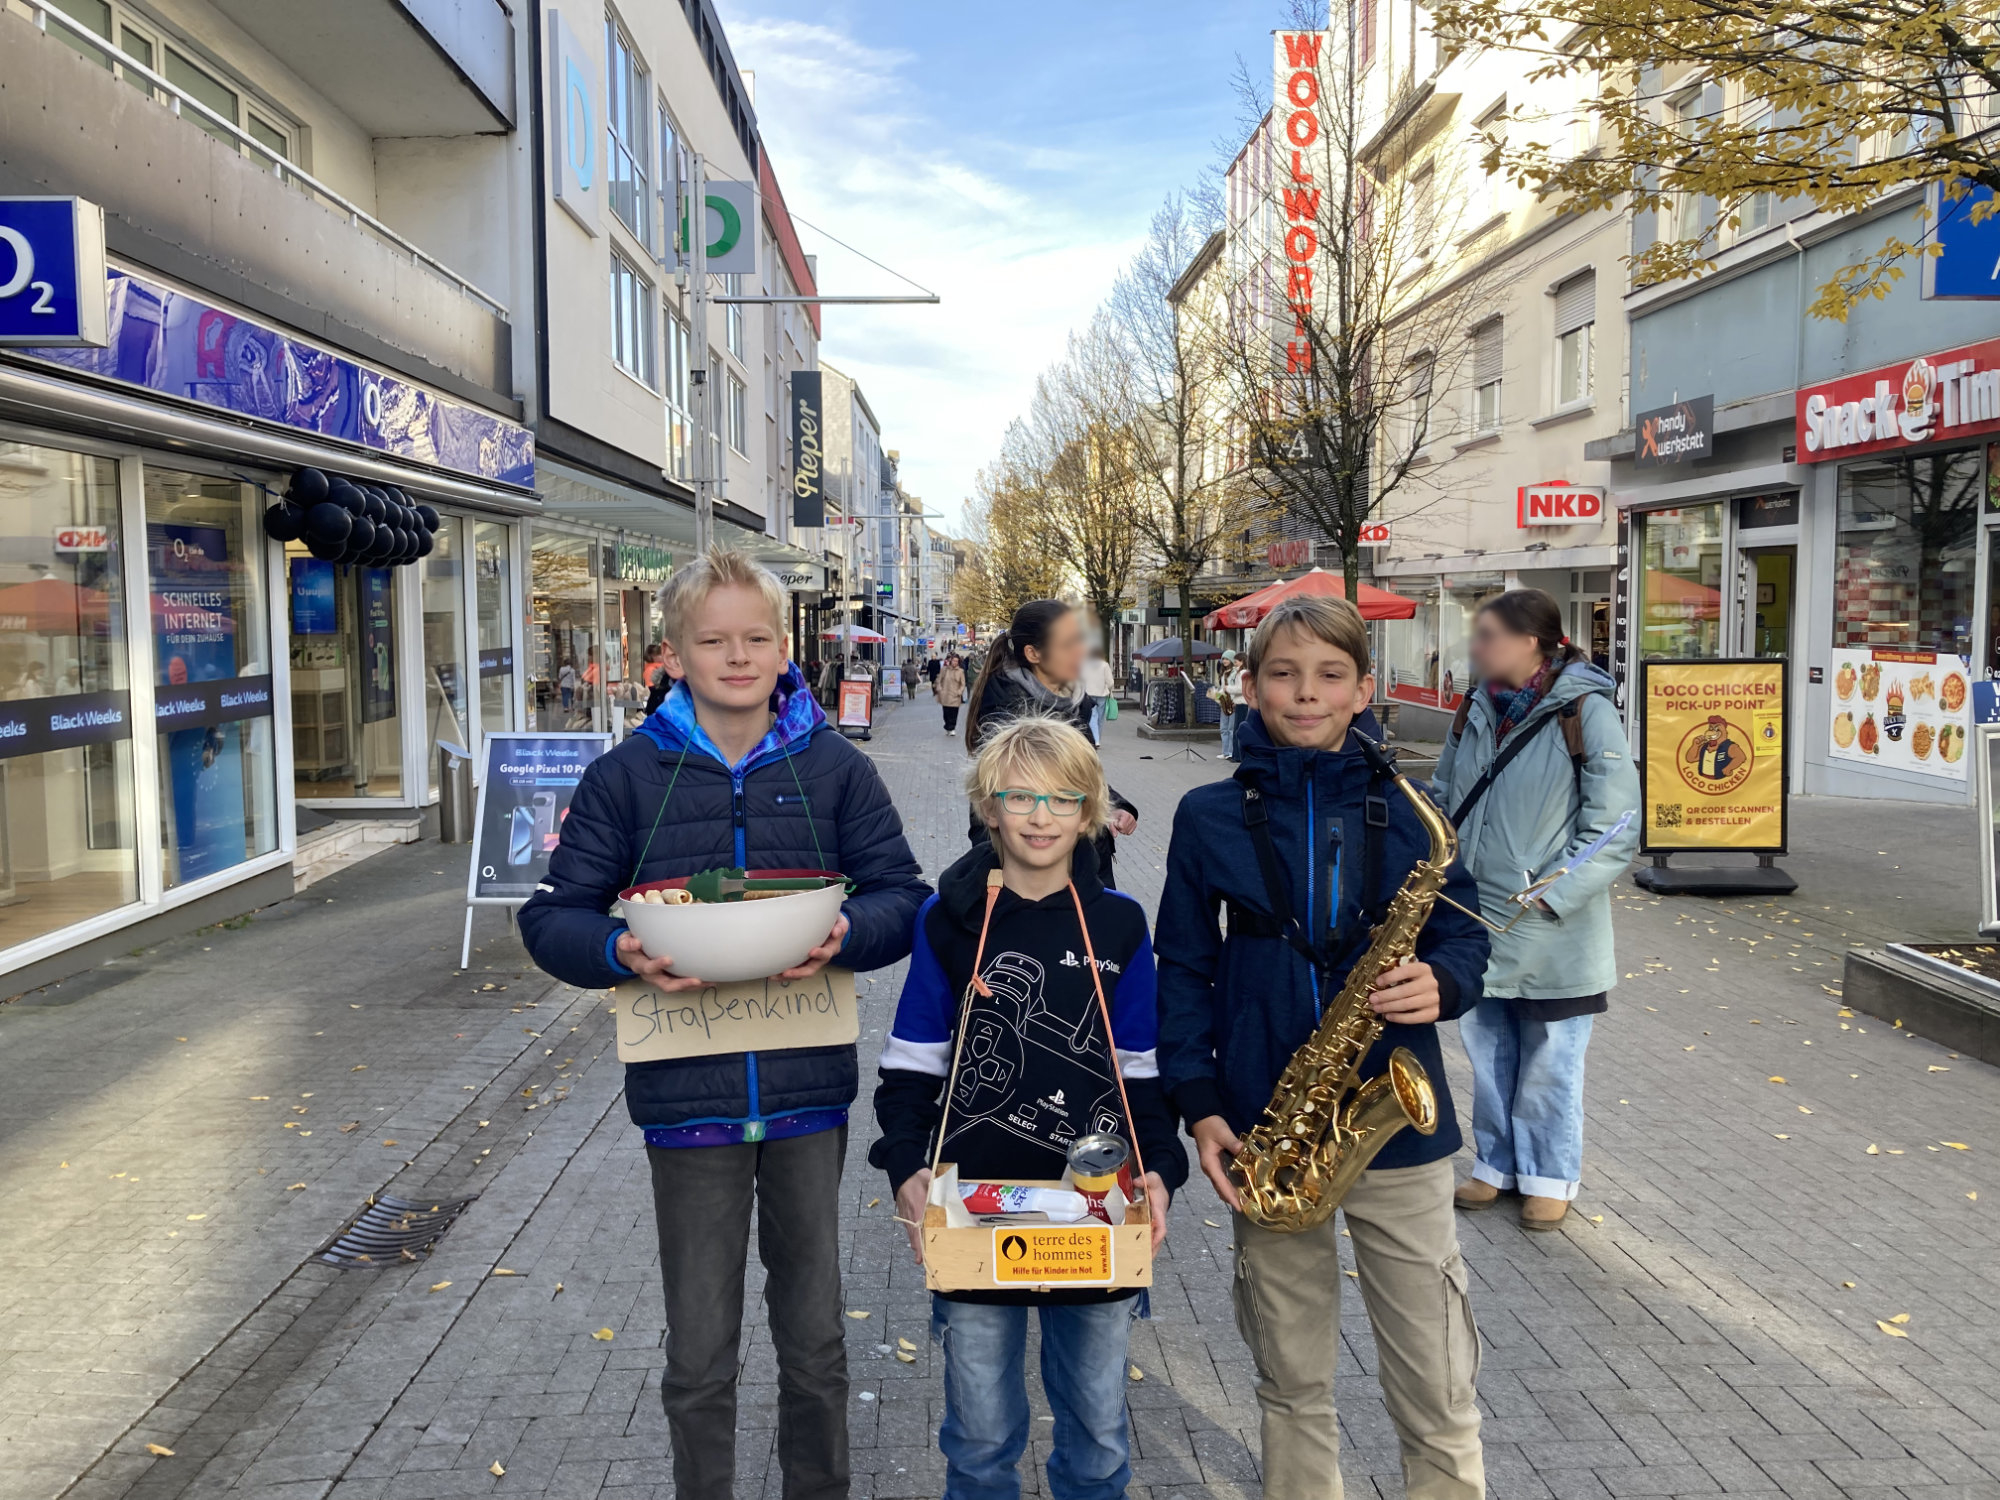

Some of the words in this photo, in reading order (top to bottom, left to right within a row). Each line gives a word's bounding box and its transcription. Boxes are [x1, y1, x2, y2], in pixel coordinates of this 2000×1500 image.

[1282, 35, 1324, 374] WOOLWORTH
[1805, 380, 1900, 452] Snack
[1937, 359, 2000, 428] Tim
[793, 398, 824, 498] Pieper
[1529, 494, 1600, 517] NKD
[1358, 525, 1389, 541] KD
[162, 592, 222, 607] SCHNELLES
[164, 612, 223, 630] INTERNET
[1654, 684, 1699, 697] LOCO
[1702, 683, 1776, 696] CHICKEN
[221, 694, 243, 707] Black
[243, 690, 268, 704] Weeks
[1666, 700, 1721, 711] PICK-UP
[1724, 699, 1765, 710] POINT
[156, 702, 176, 717] lack
[176, 699, 206, 713] Weeks
[51, 713, 84, 731] Black
[84, 709, 122, 726] Weeks
[0, 721, 27, 738] eeks
[515, 749, 543, 757] Black
[545, 749, 579, 757] Weeks
[500, 764, 534, 775] Google
[536, 764, 560, 774] Pixel
[562, 764, 573, 774] 10
[575, 765, 586, 774] Pr
[1682, 766, 1706, 789] LOCO
[1707, 767, 1747, 791] CHICKEN
[1701, 806, 1726, 814] CODE
[1695, 817, 1751, 825] BESTELLEN
[624, 974, 840, 1046] Straßenkind
[1008, 1113, 1038, 1131] SELECT
[1049, 1133, 1074, 1147] START
[1033, 1236, 1065, 1245] terre
[1069, 1233, 1092, 1245] des
[1033, 1248, 1092, 1260] hommes
[1044, 1266, 1068, 1274] Kinder
[1070, 1266, 1077, 1274] in
[1079, 1266, 1092, 1274] Not
